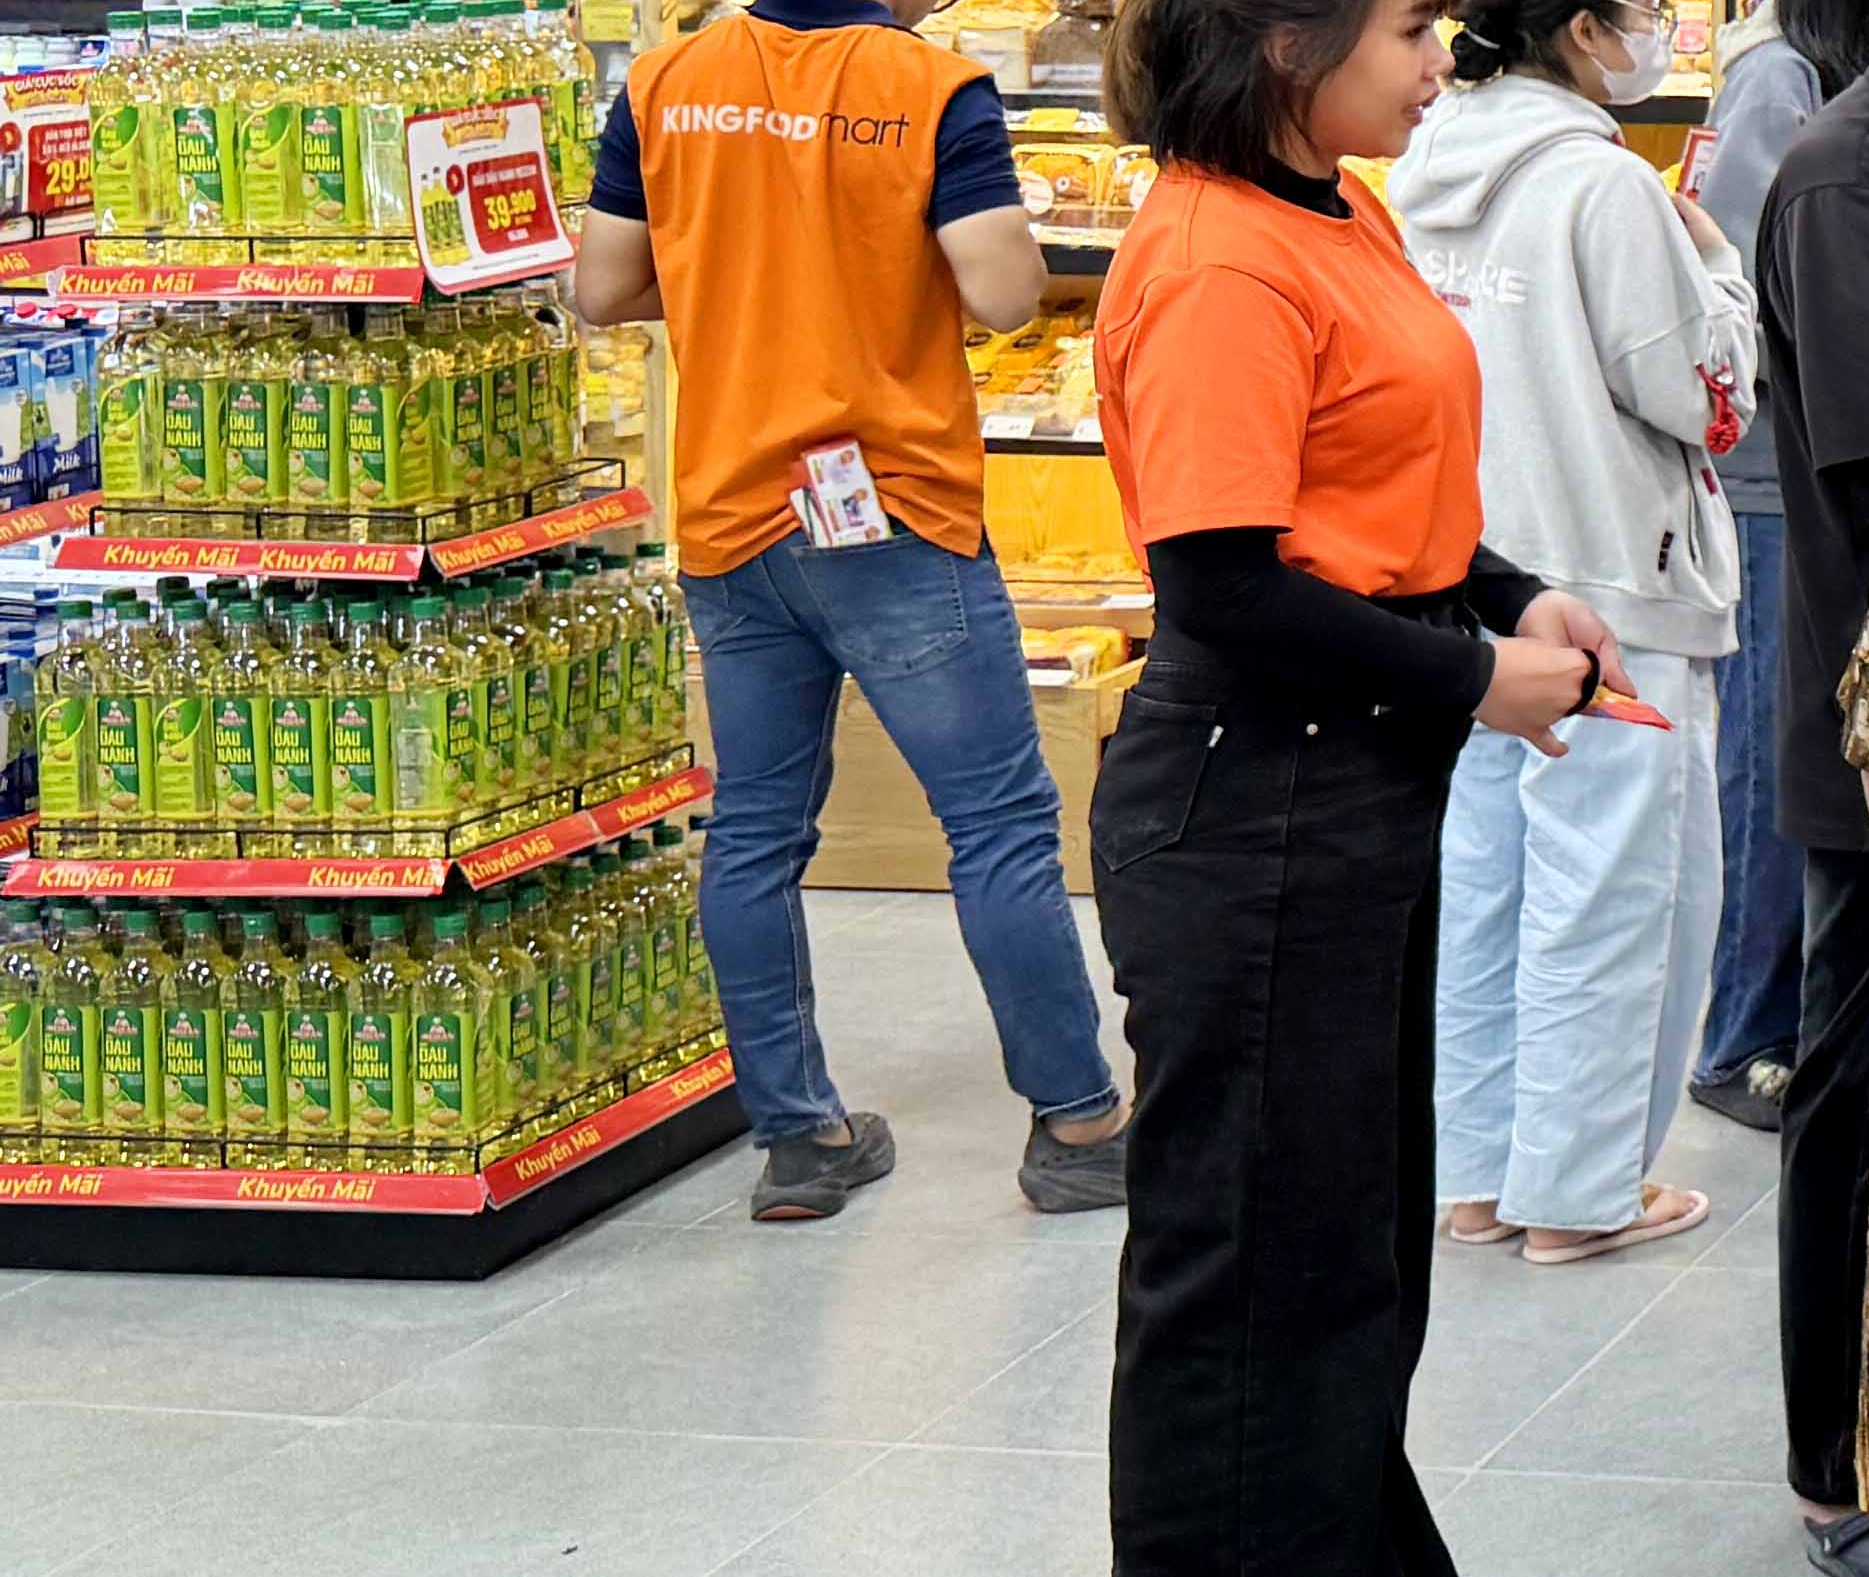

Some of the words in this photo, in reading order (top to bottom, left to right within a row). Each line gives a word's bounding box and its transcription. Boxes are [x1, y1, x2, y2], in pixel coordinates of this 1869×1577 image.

[59, 270, 147, 300] Khuyến
[151, 267, 195, 293] Mãi
[102, 543, 192, 571] Khuyến
[195, 542, 240, 568] Mãi
[259, 545, 349, 573] Khuyến
[352, 546, 397, 573] Mãi
[38, 866, 125, 893] Khuyến
[130, 865, 174, 888] Mãi
[237, 1176, 326, 1202] Khuyến
[330, 1177, 376, 1201] Mãi
